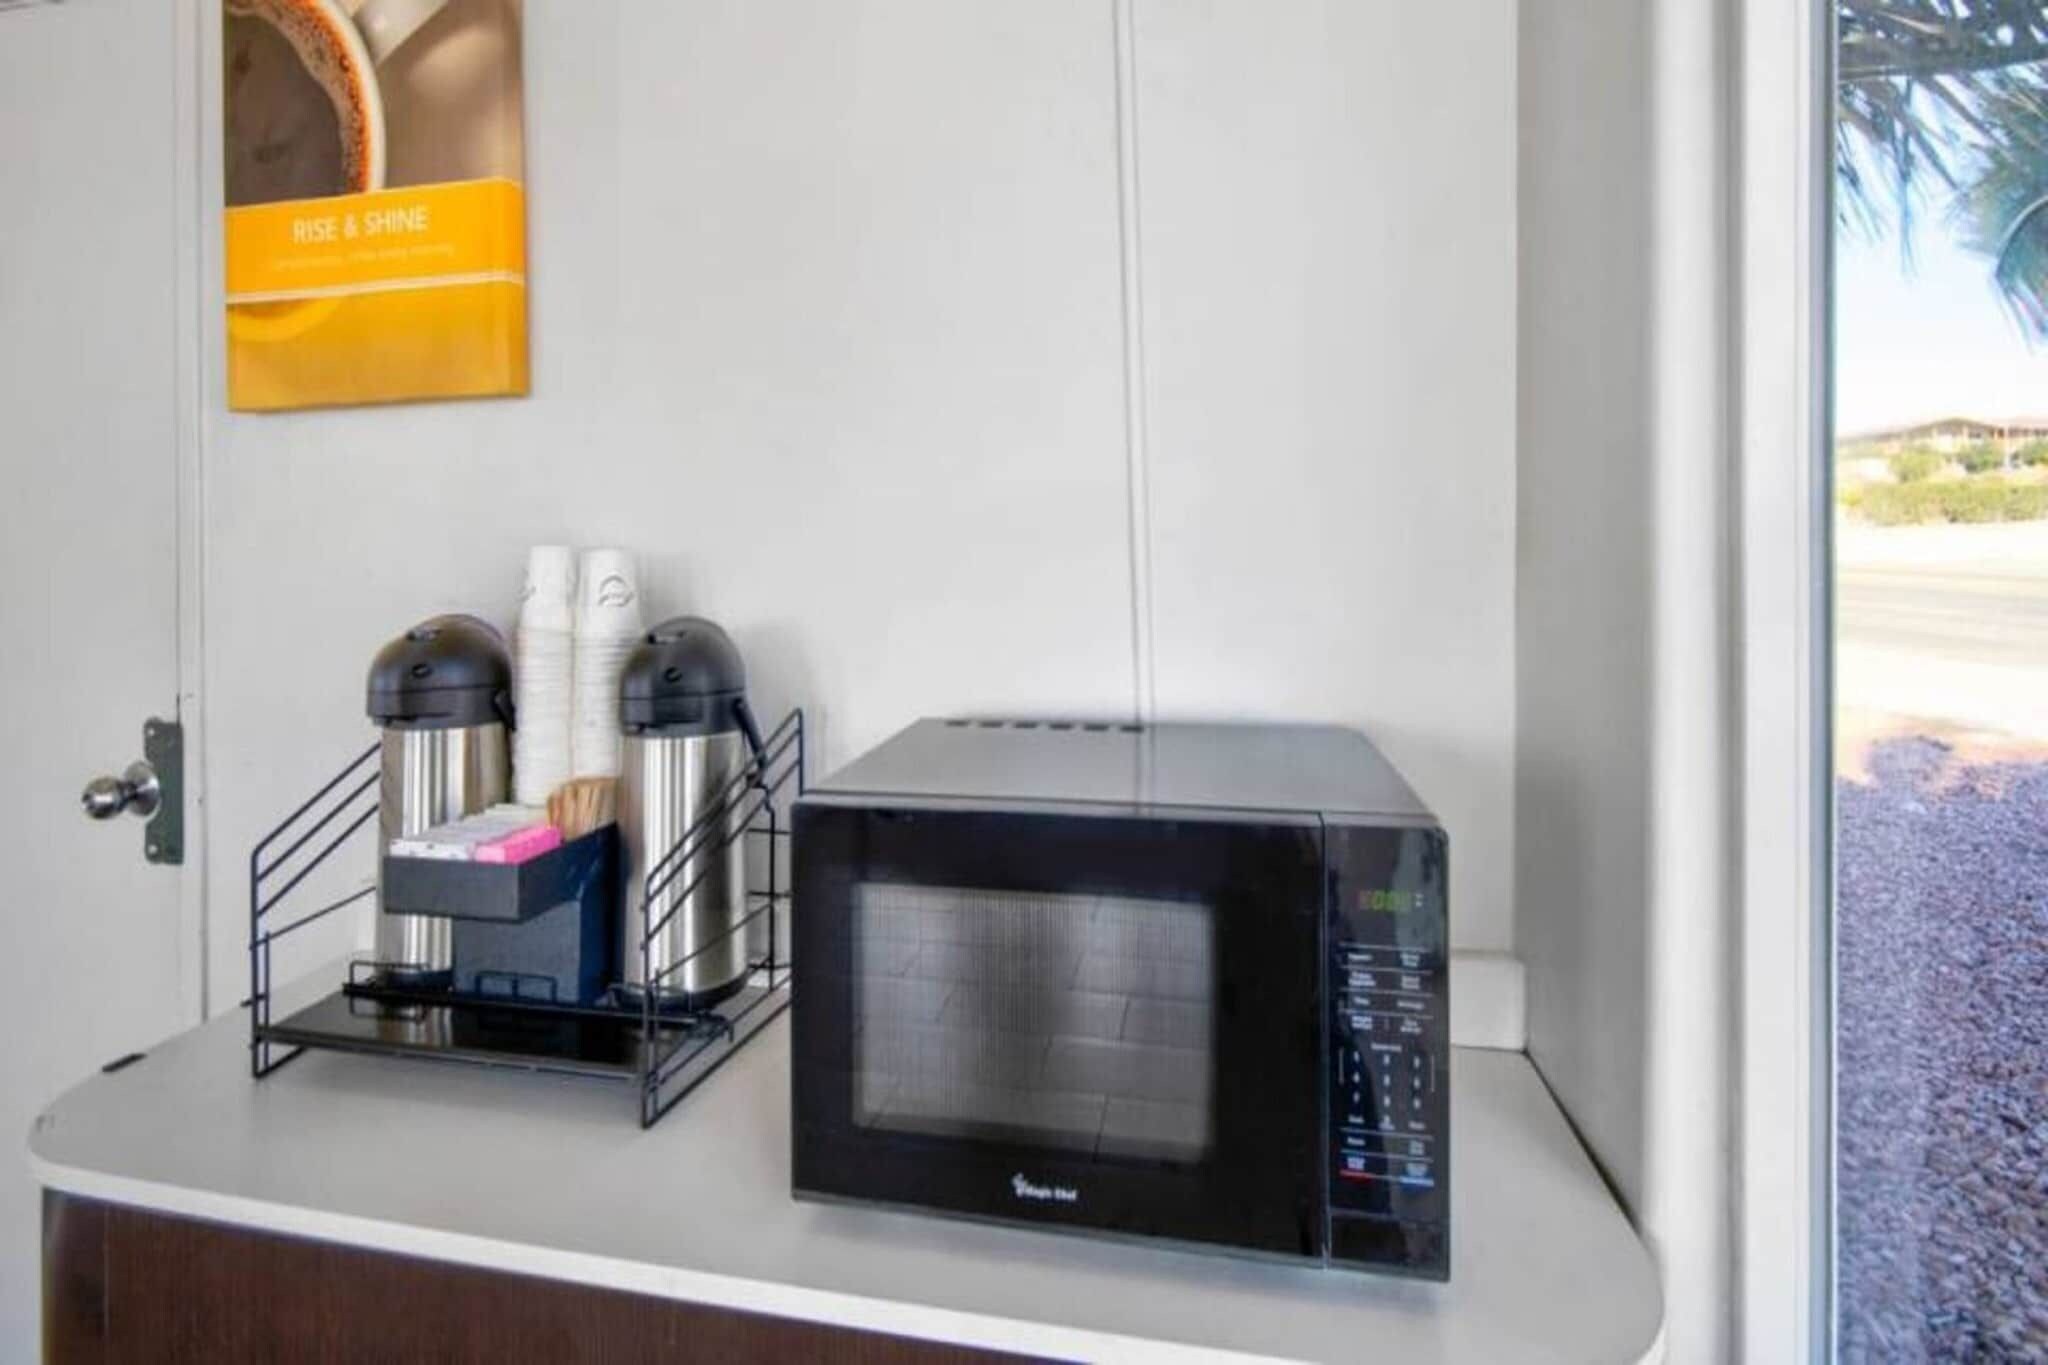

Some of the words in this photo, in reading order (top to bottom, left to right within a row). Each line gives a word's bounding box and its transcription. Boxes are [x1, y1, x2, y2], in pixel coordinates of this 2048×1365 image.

[292, 215, 338, 243] RISE
[344, 217, 359, 239] &
[365, 205, 428, 234] SHINE
